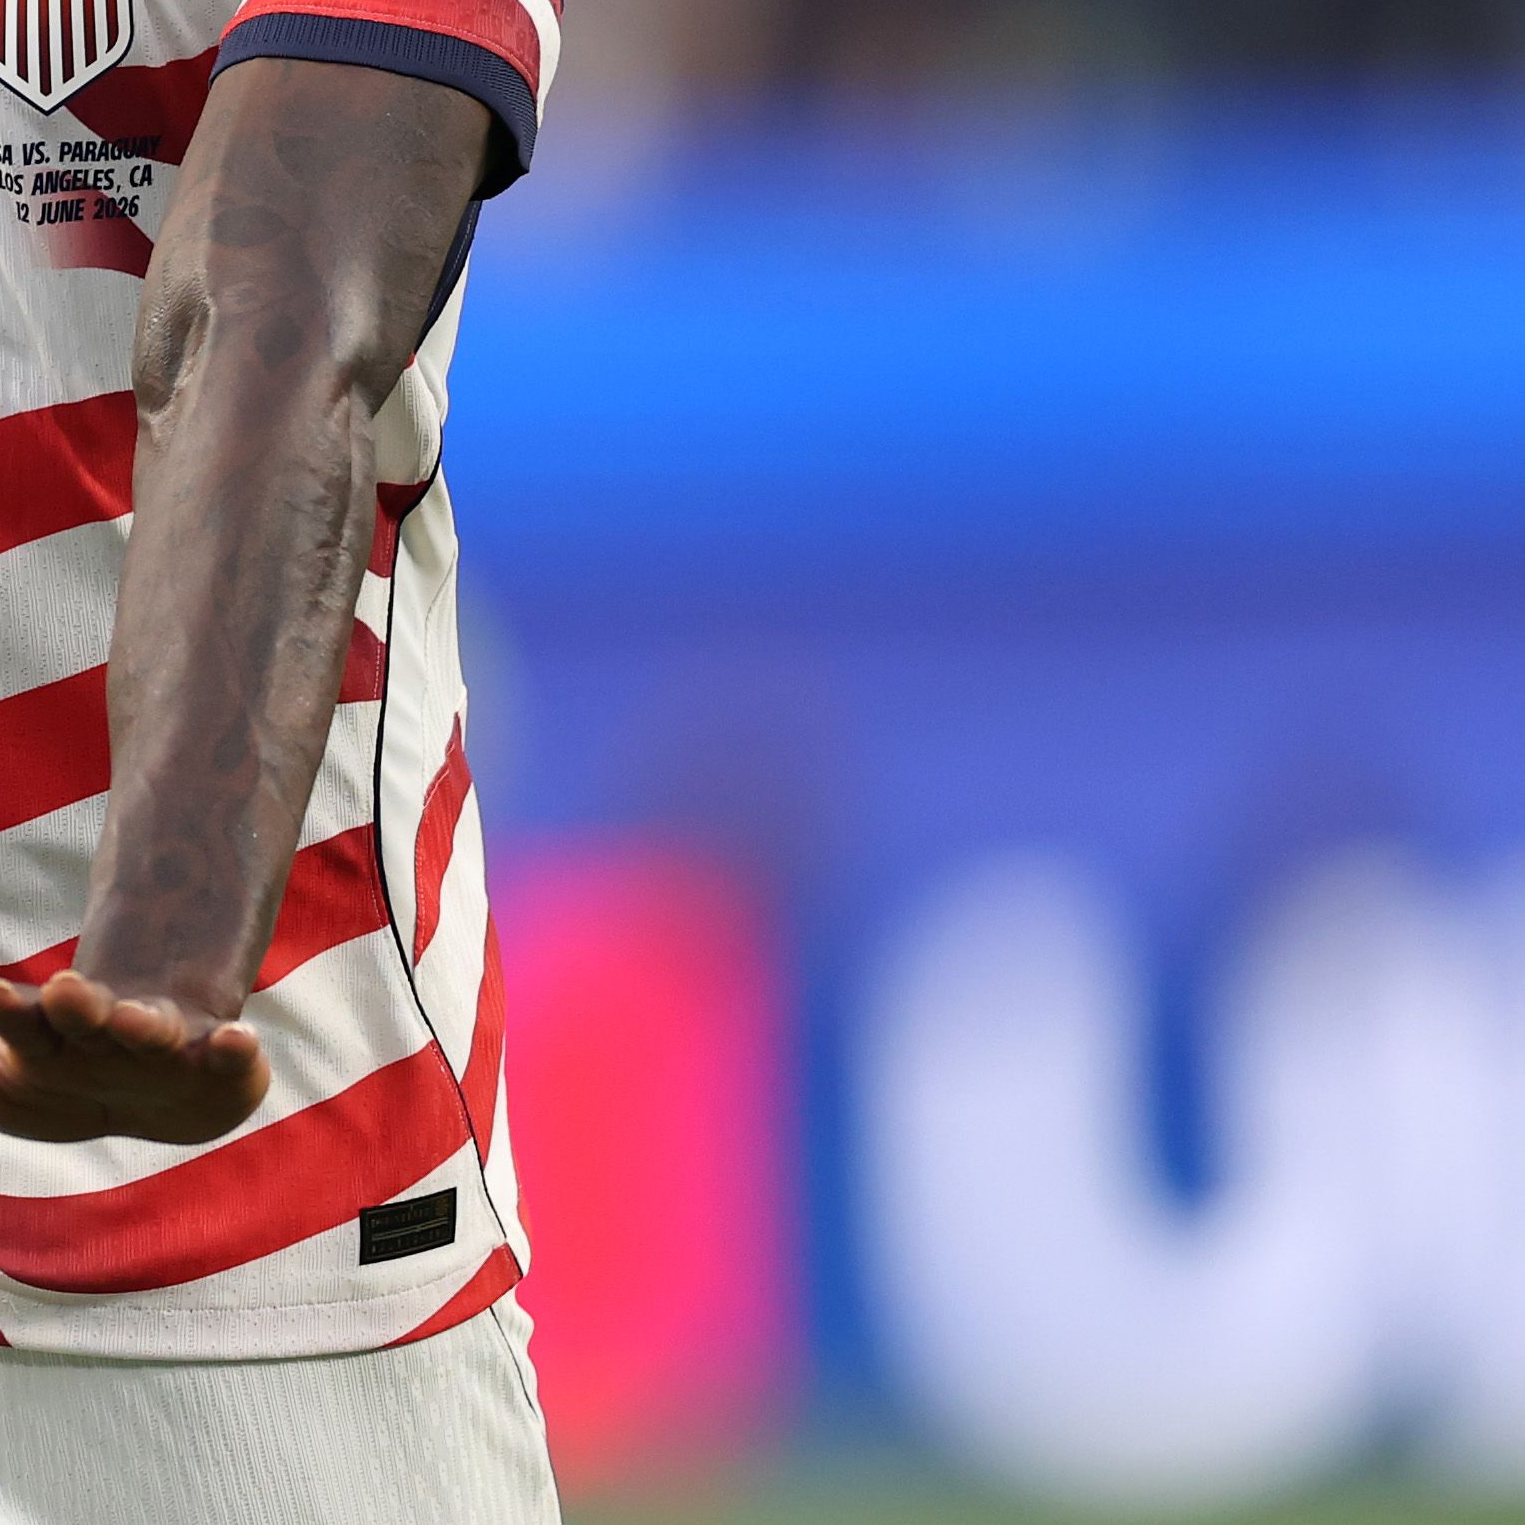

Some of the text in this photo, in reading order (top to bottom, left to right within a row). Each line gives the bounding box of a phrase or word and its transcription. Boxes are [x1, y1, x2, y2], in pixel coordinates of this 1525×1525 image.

[22, 141, 51, 166] VS.
[58, 135, 163, 163] PARAGUAY
[31, 168, 121, 196] ANGELES,
[129, 164, 153, 188] CA
[16, 195, 140, 226] 12 JUNE 2026
